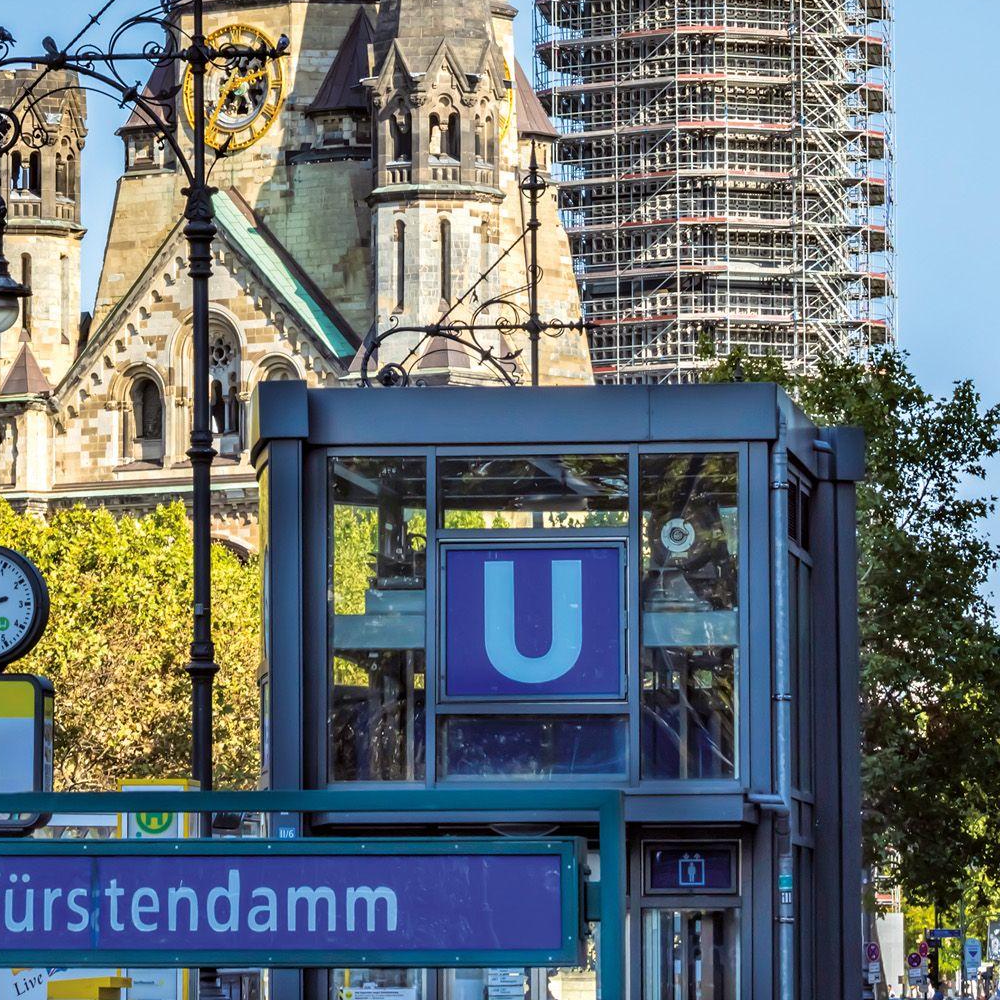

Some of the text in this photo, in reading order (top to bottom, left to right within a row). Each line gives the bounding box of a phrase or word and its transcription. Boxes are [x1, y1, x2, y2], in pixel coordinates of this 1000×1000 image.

[14, 619, 19, 627] 4
[484, 560, 583, 684] U
[13, 973, 44, 996] Live
